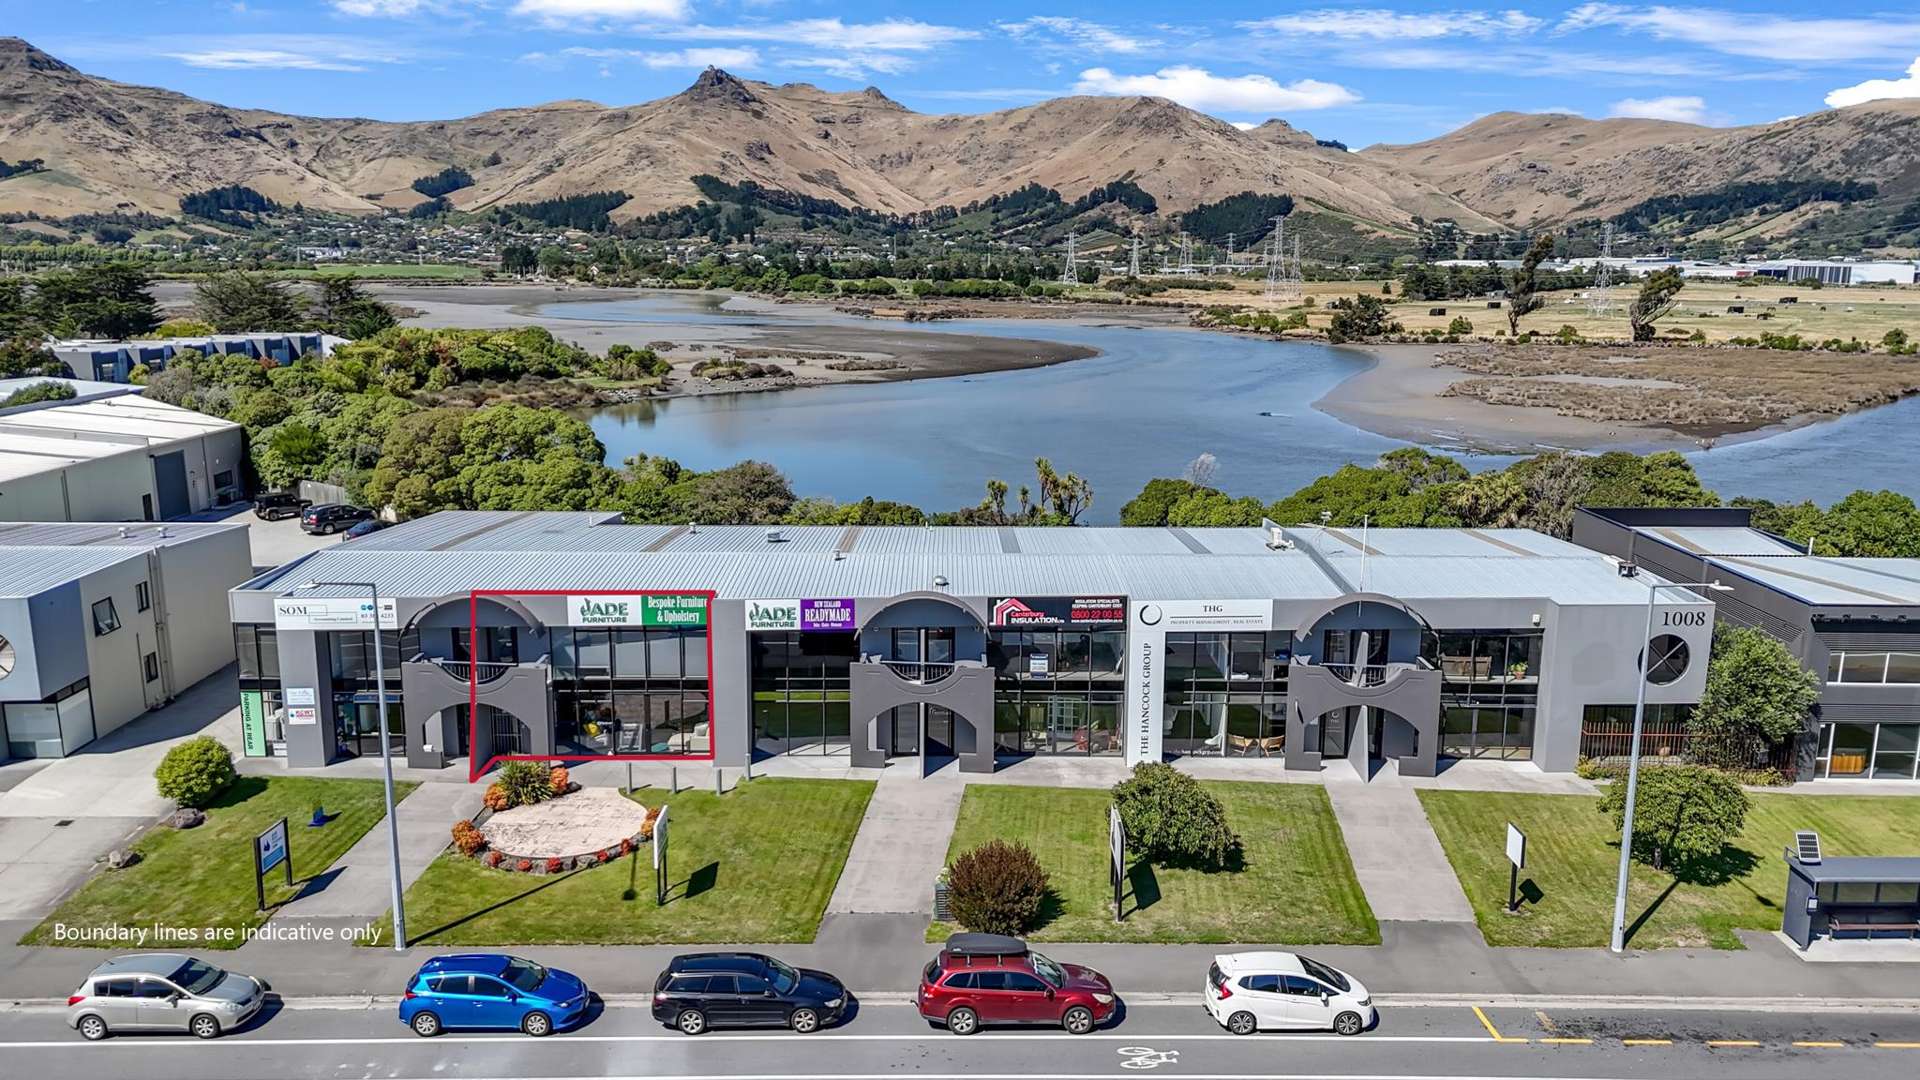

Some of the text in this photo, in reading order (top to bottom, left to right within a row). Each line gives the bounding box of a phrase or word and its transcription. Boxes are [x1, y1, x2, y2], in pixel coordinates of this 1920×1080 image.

[580, 597, 629, 616] JADE
[648, 596, 675, 609] Bespoke
[279, 606, 307, 615] SOM
[657, 610, 699, 623] & Upholstery
[749, 602, 797, 621] JADE
[805, 608, 851, 622] READYMADE
[1071, 610, 1123, 619] 0800 22 00 55
[1663, 611, 1706, 626] 1008
[1141, 643, 1152, 755] THE HANCOCK GROUP
[244, 693, 254, 750] PARKING AT REAR
